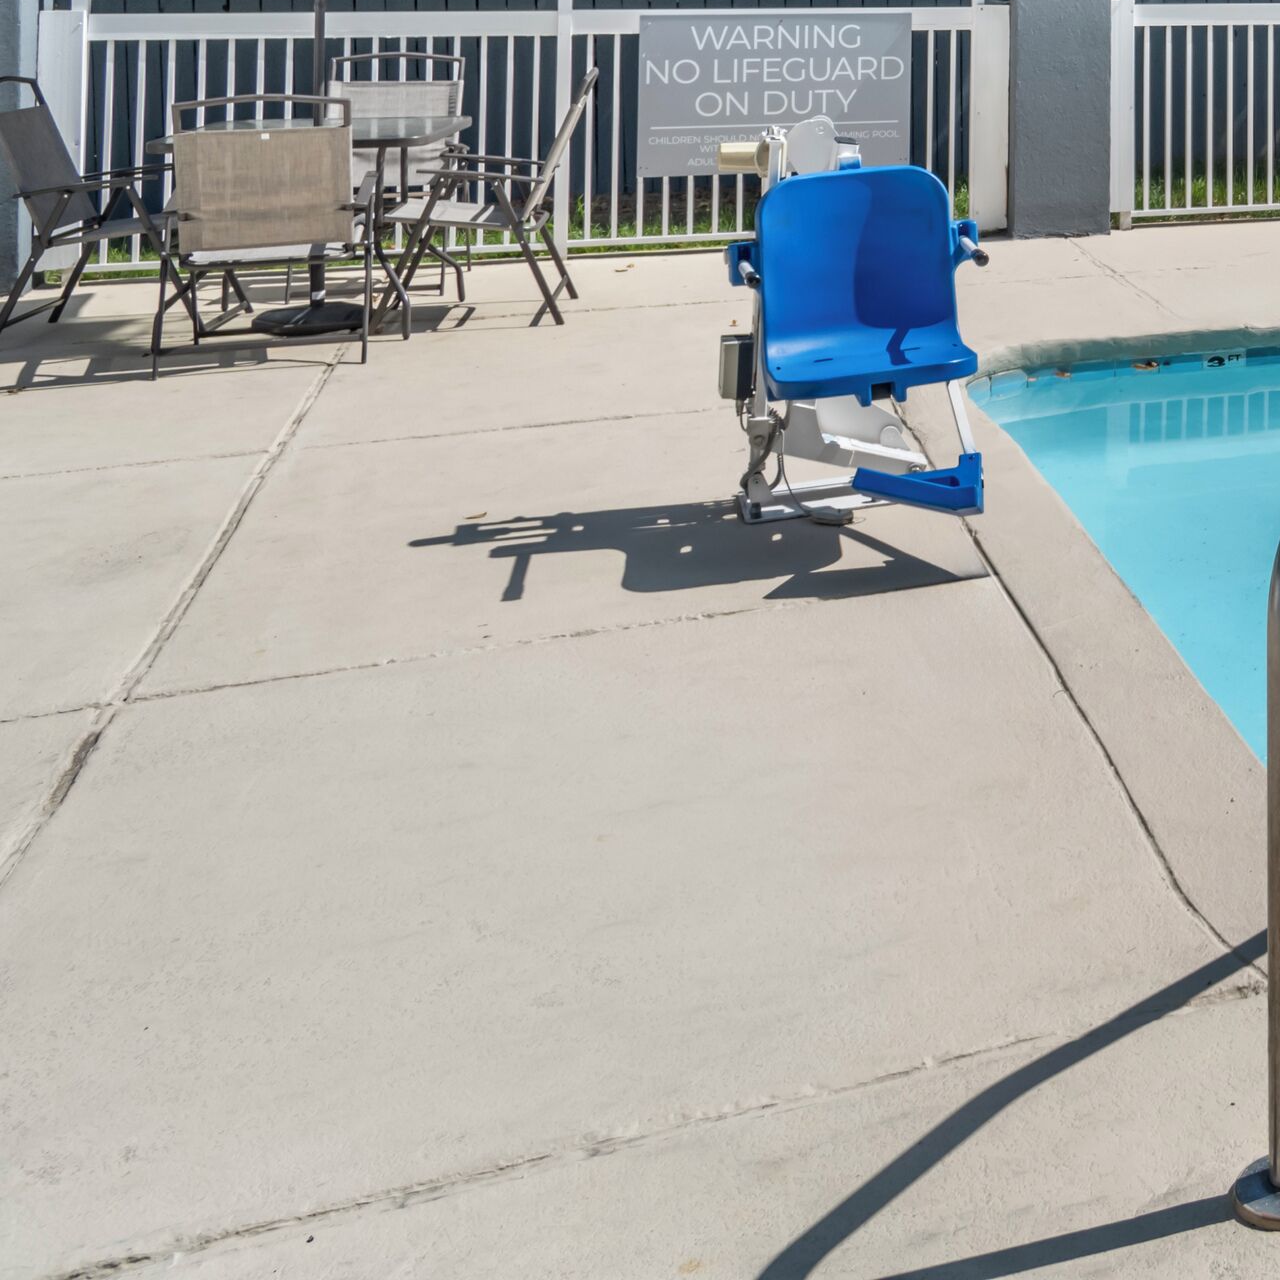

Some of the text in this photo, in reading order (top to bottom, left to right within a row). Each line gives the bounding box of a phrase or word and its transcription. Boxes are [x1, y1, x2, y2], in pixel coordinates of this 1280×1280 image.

[691, 24, 861, 51] WARNING
[645, 56, 904, 85] NO LIFEGUARD
[695, 89, 857, 117] ON DUTY
[648, 135, 701, 145] CHILDREN
[703, 133, 747, 144] SHOULD
[872, 129, 900, 138] POOL
[687, 157, 718, 166] ADUL
